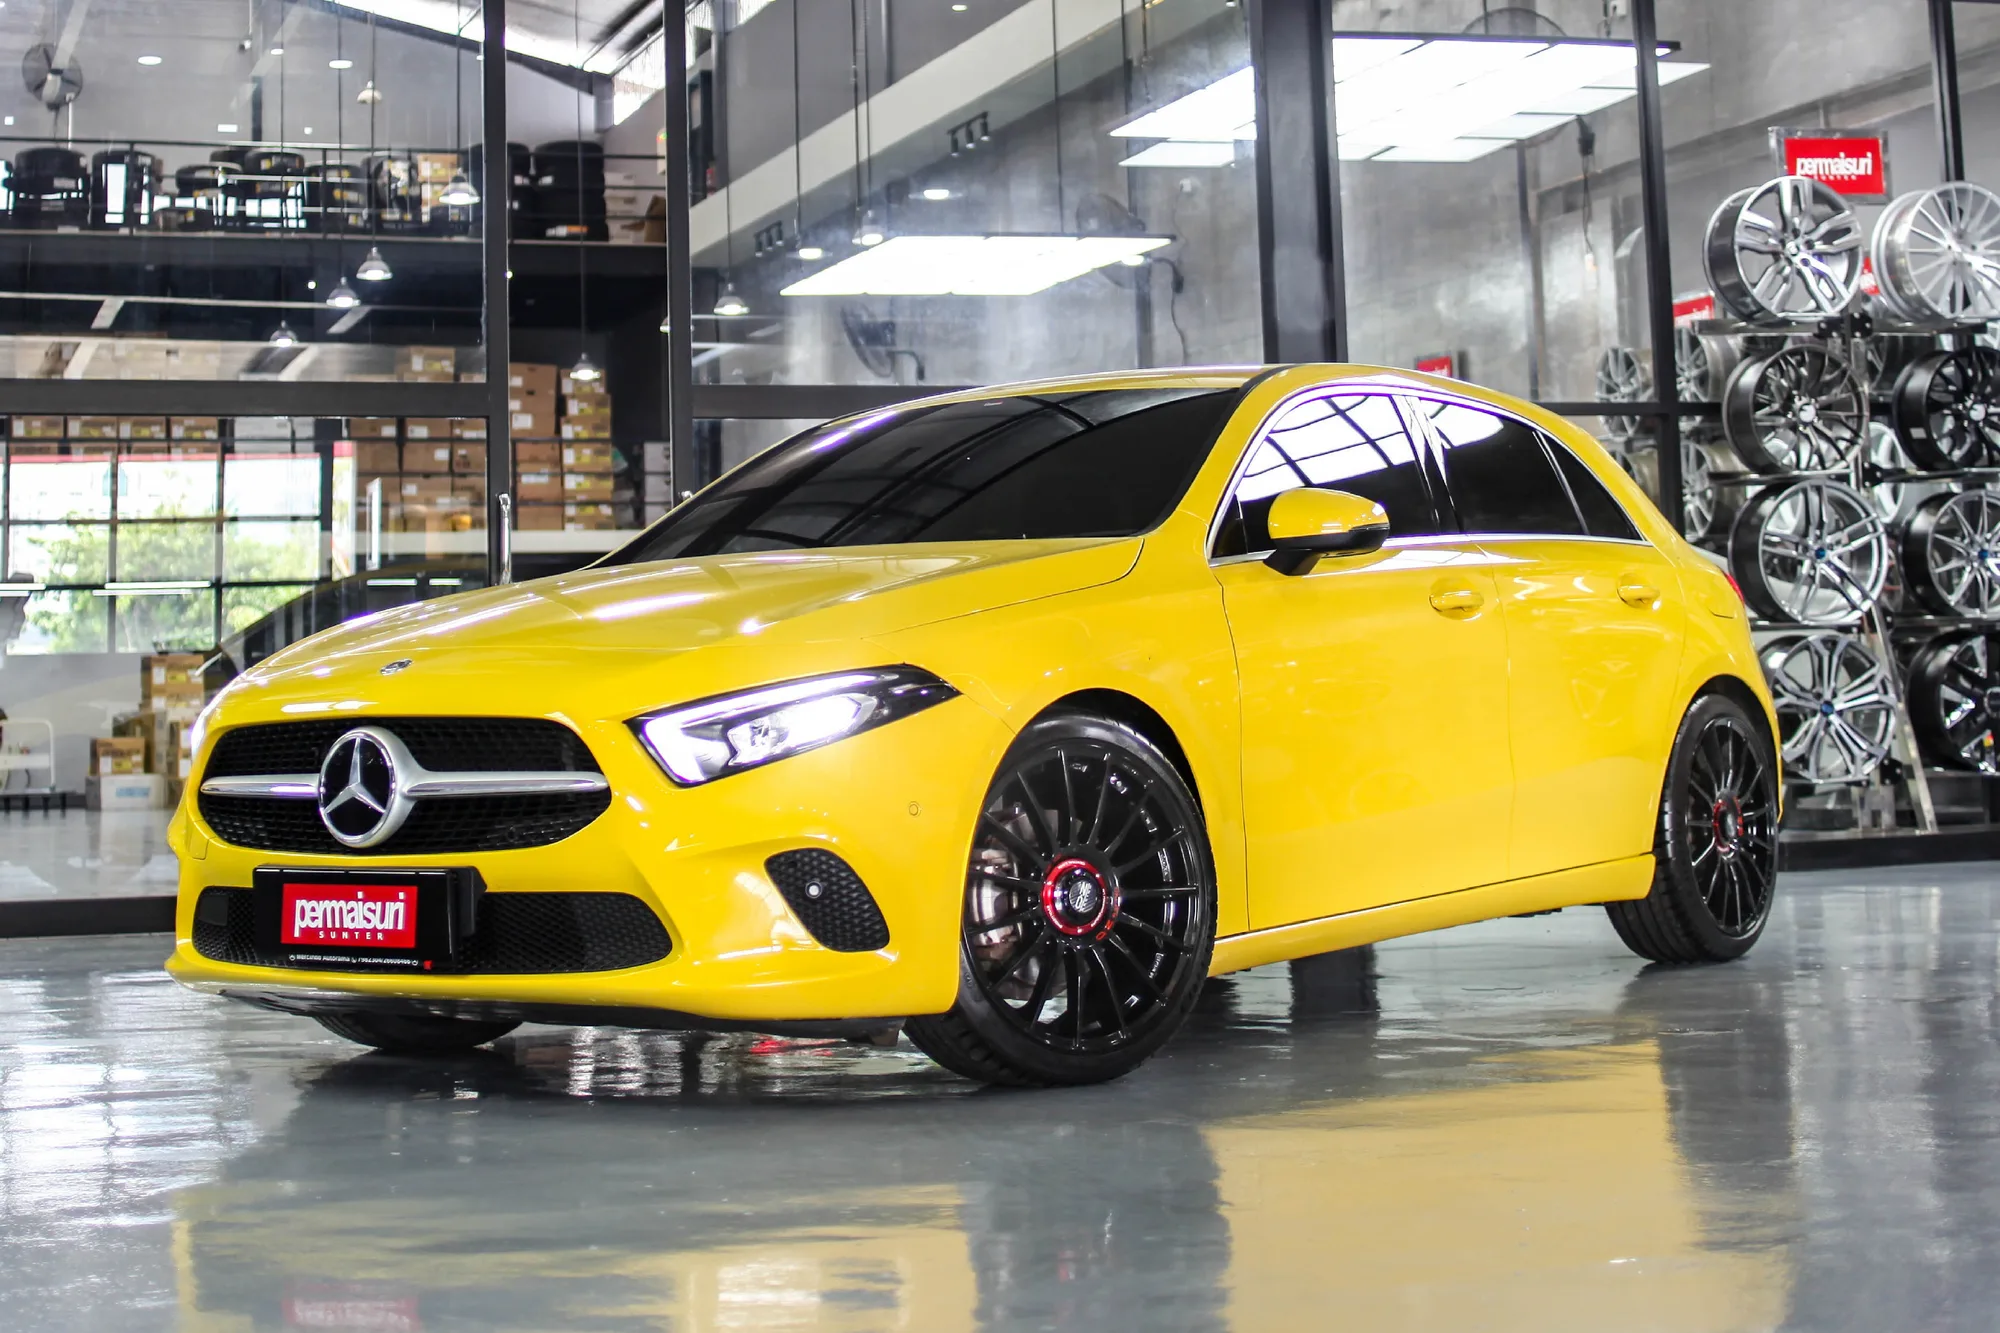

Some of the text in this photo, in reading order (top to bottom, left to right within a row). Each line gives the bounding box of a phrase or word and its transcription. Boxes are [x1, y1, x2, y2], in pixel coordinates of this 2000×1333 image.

[1796, 151, 1873, 176] permaisuri
[294, 891, 405, 938] permaisuri
[319, 930, 384, 941] SUNTER
